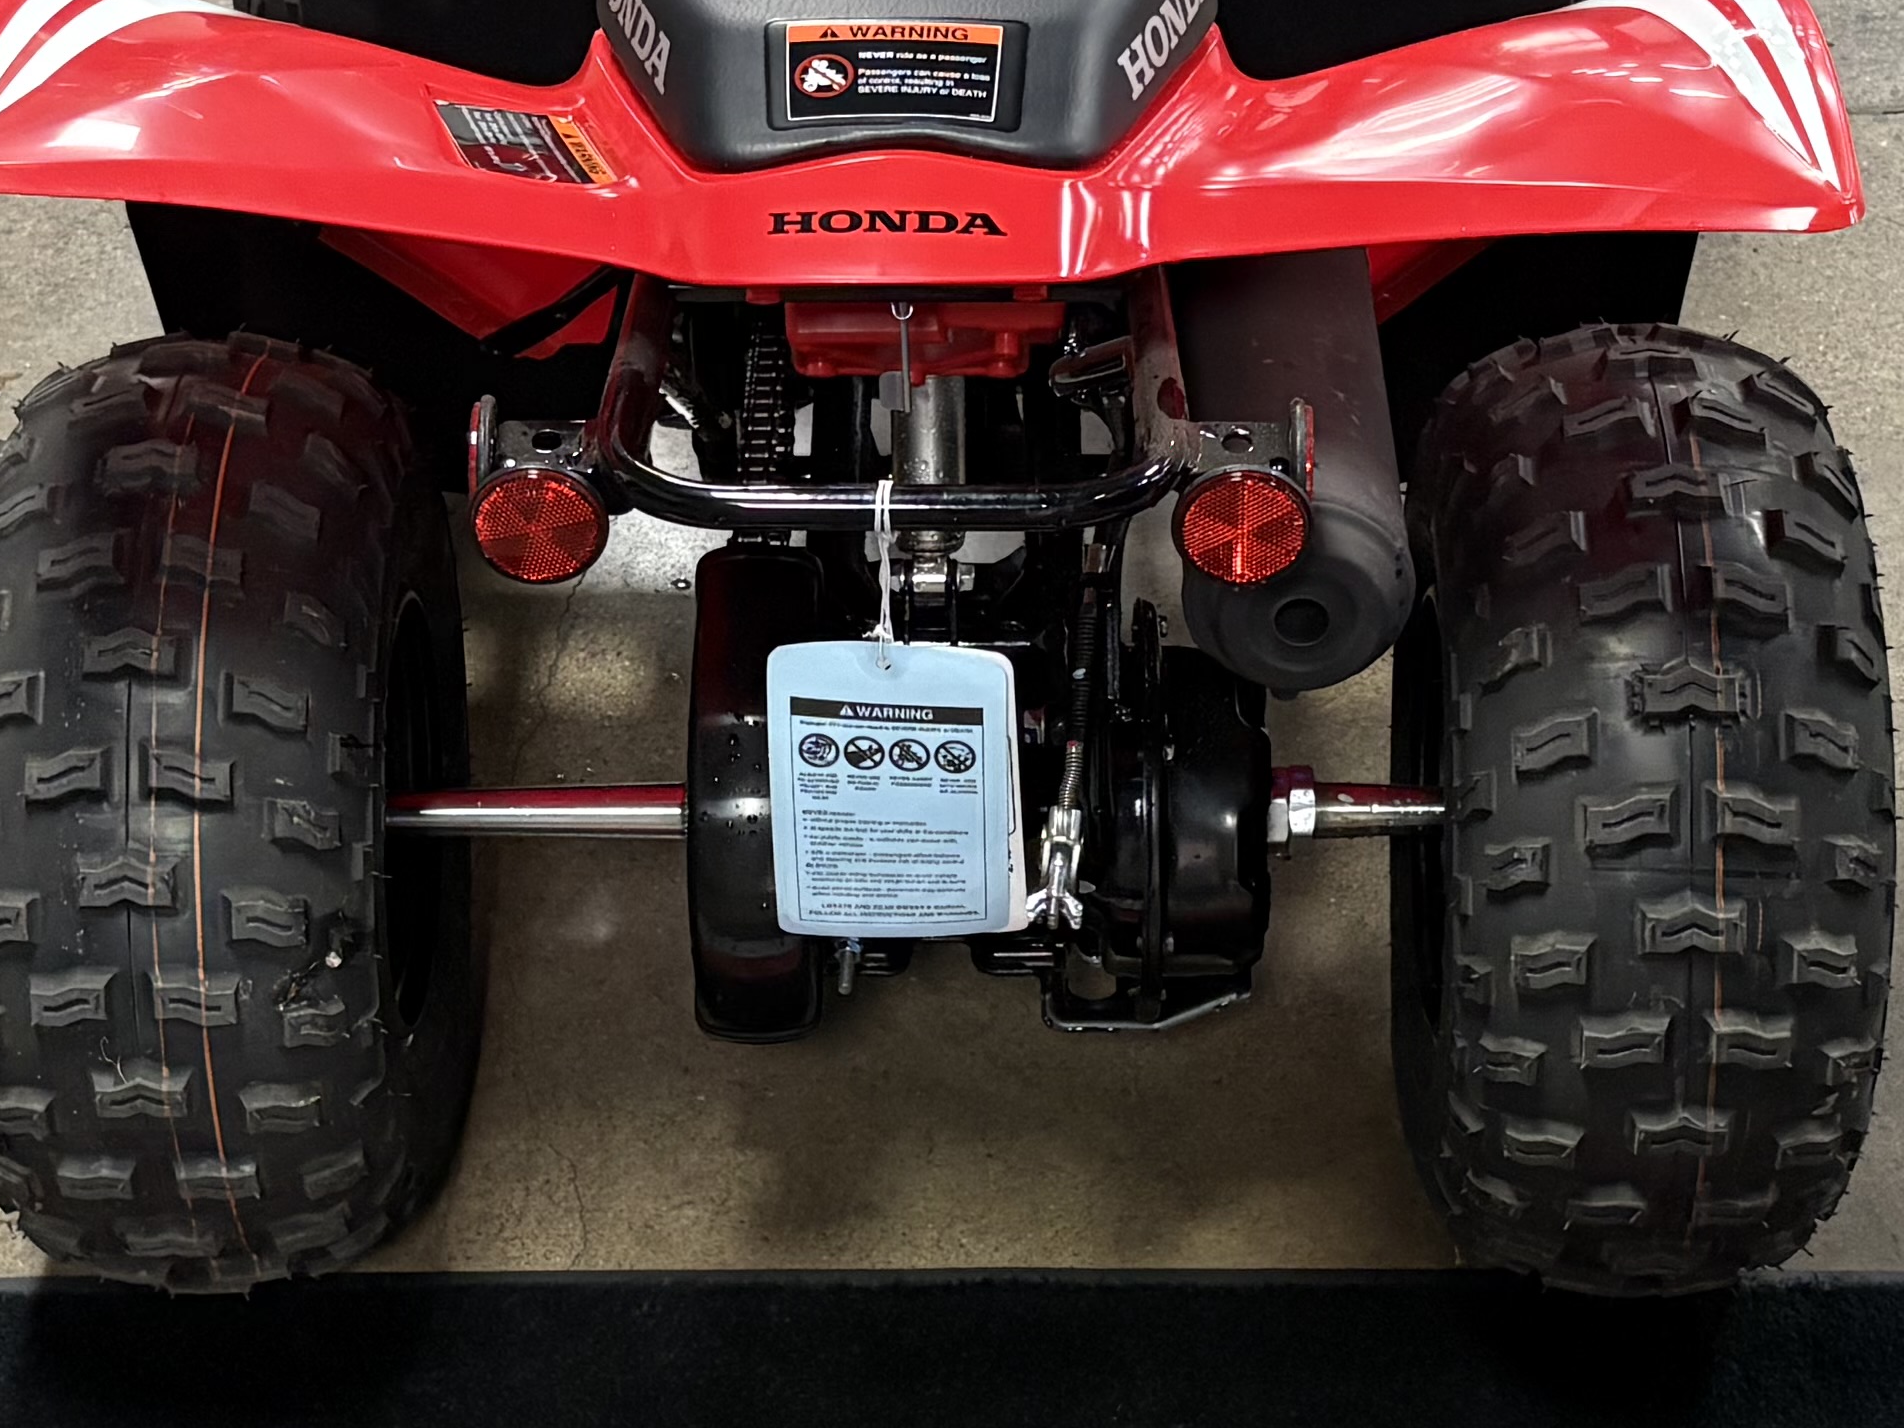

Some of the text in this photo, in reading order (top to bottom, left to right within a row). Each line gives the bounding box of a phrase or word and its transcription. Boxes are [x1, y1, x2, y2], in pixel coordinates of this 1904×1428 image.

[849, 26, 969, 40] WARNING
[858, 51, 894, 59] NEVER
[938, 54, 988, 64] passenger
[858, 68, 912, 78] Passengers
[858, 85, 898, 94] SEVERE
[901, 86, 937, 95] INJURY
[951, 88, 987, 98] DEATH
[767, 210, 1008, 236] HONDA
[856, 706, 933, 720] WARNING
